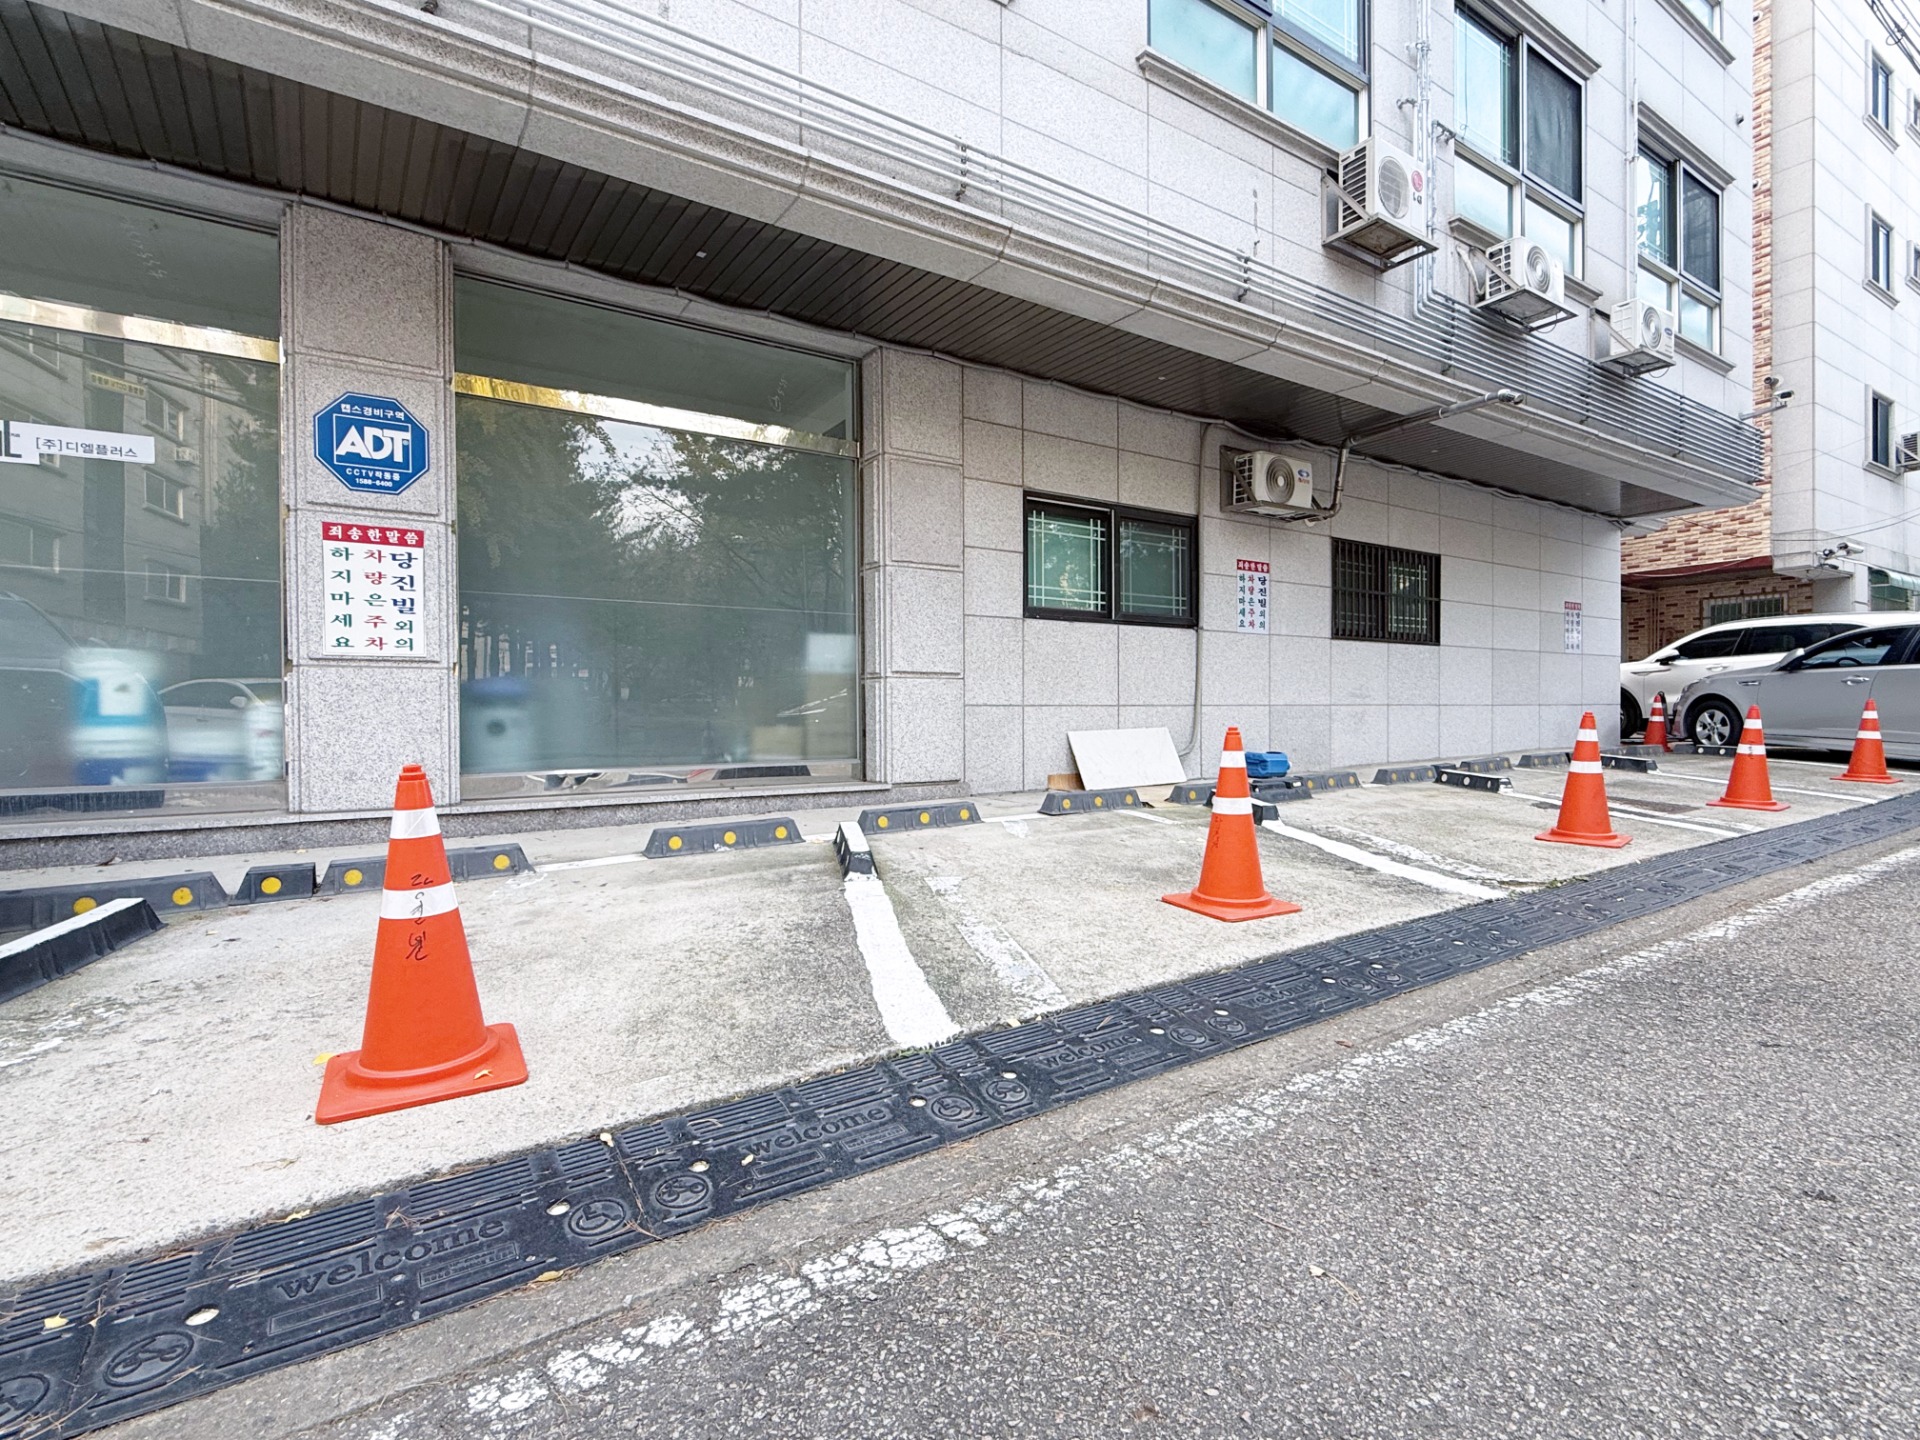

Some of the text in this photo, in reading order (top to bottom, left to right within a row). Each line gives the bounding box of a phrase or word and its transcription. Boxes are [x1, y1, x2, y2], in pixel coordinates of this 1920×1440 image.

[335, 425, 410, 463] ADT
[1039, 1034, 1139, 1069] welcome
[739, 1105, 888, 1158] welcome
[275, 1217, 505, 1299] welcome
